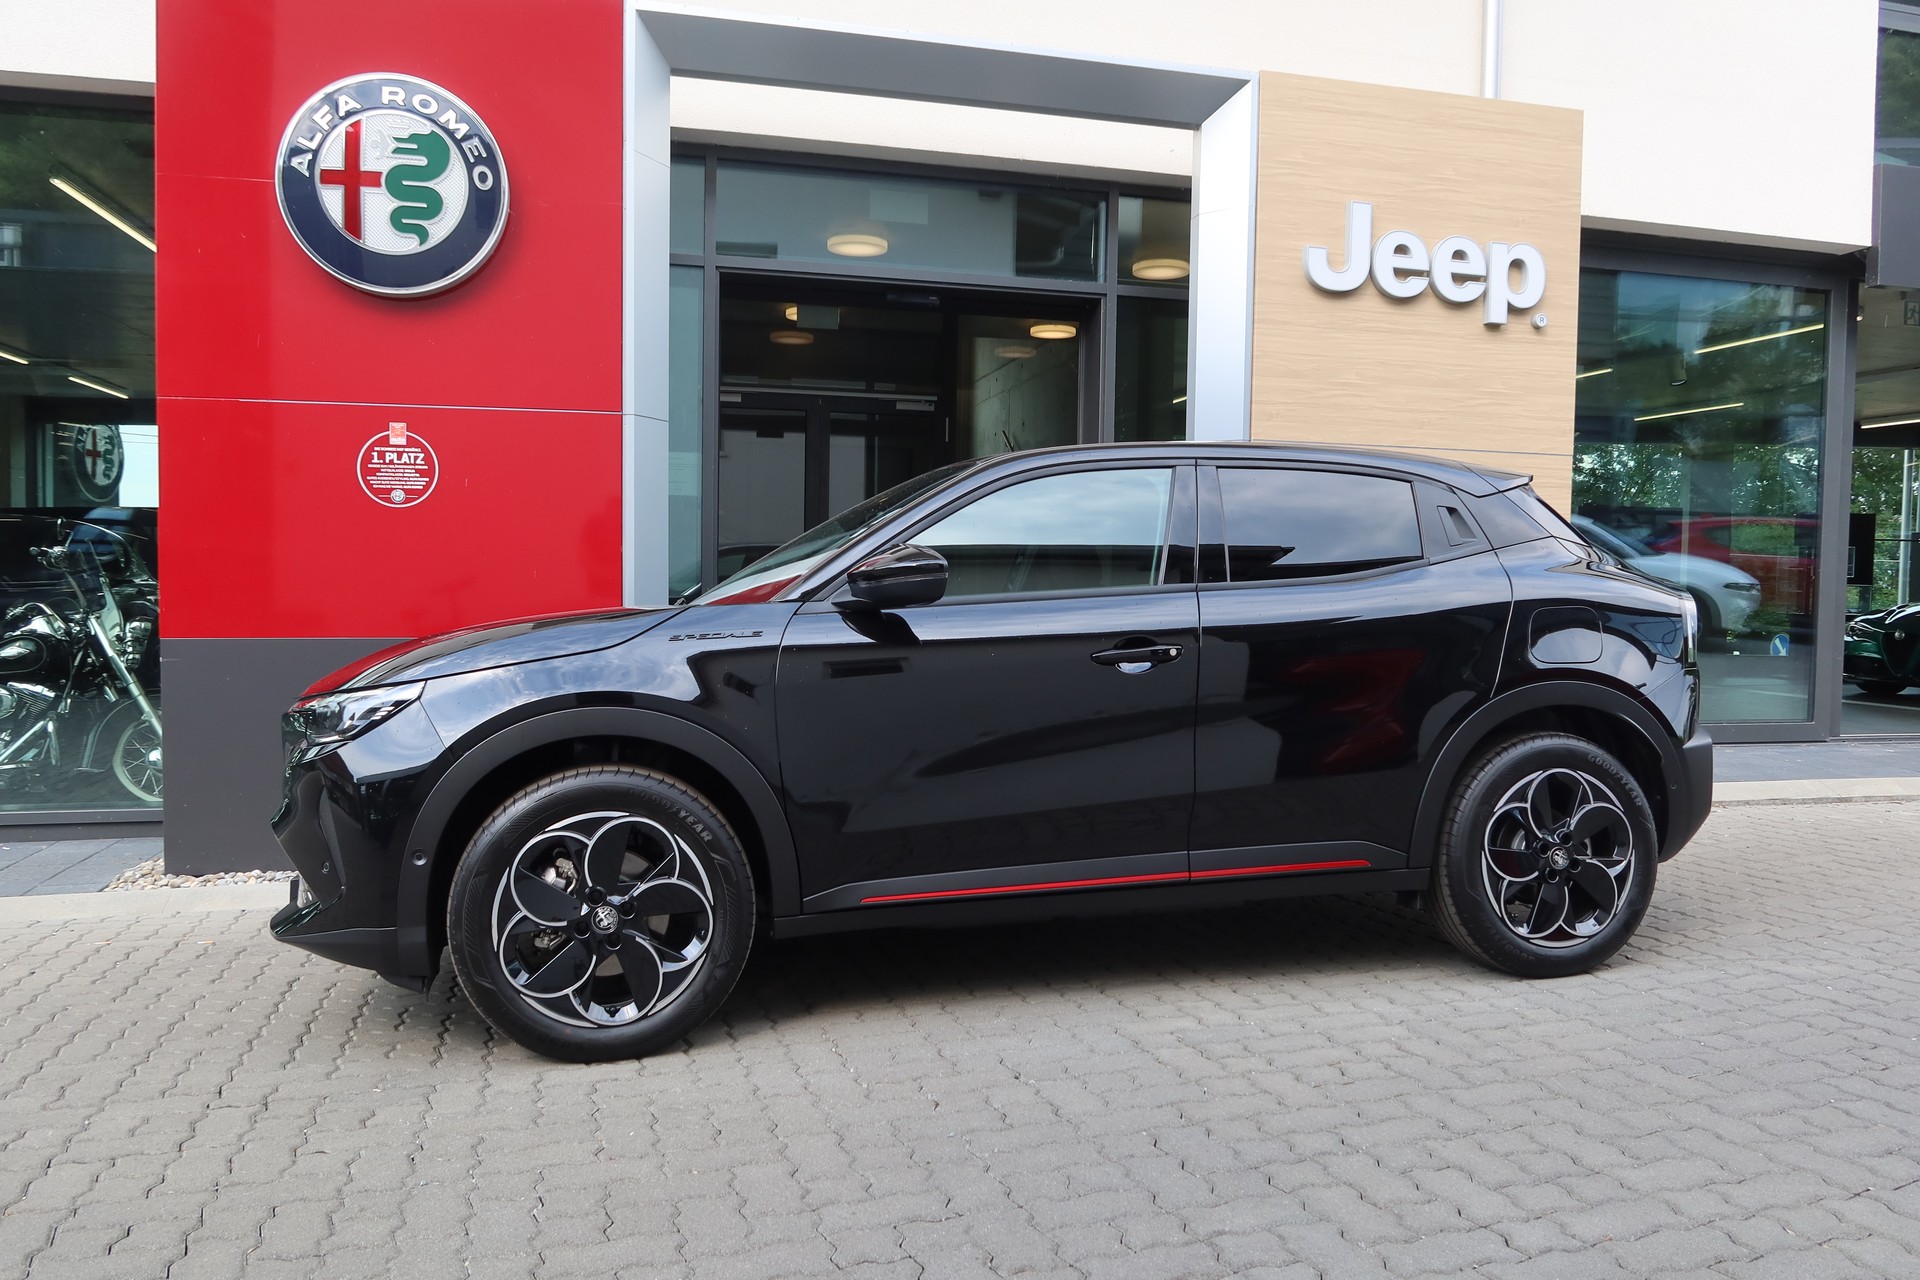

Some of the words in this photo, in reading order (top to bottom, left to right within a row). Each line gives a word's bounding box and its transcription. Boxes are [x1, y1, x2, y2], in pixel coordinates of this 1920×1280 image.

[291, 94, 362, 177] ALFA
[381, 86, 493, 191] ROMEO
[1305, 201, 1546, 325] Jeep
[371, 452, 384, 463] 1.
[385, 452, 425, 464] PLATZ
[668, 630, 764, 642] SPECIALE
[1587, 752, 1642, 807] GOODYEAR
